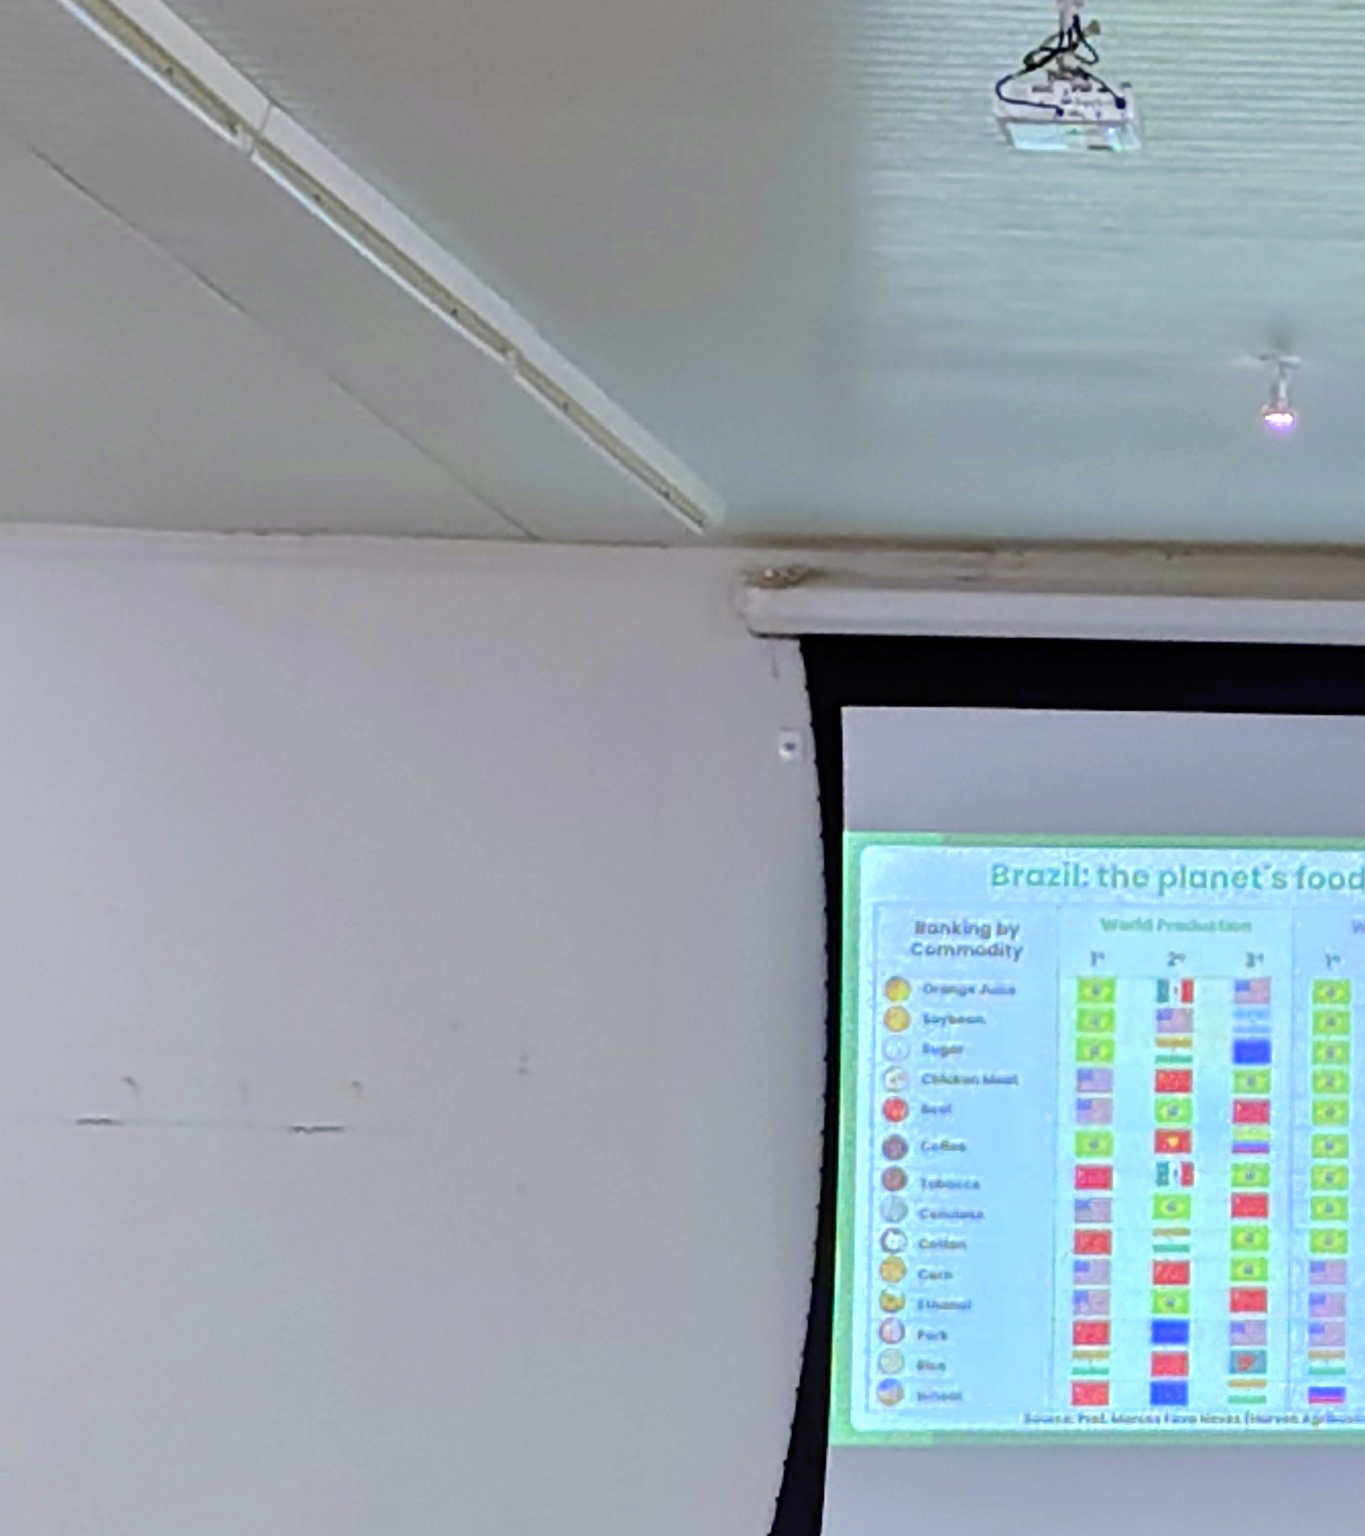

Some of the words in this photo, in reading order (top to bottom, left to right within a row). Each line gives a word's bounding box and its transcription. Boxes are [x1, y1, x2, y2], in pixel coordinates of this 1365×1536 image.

[991, 861, 1089, 888] Brazil:
[1097, 864, 1150, 889] the
[1296, 865, 1365, 891] food
[914, 920, 991, 940] Ranking
[996, 921, 1020, 941] by
[1100, 917, 1154, 932] World
[1157, 917, 1252, 932] Production
[910, 942, 1024, 962] Commodity
